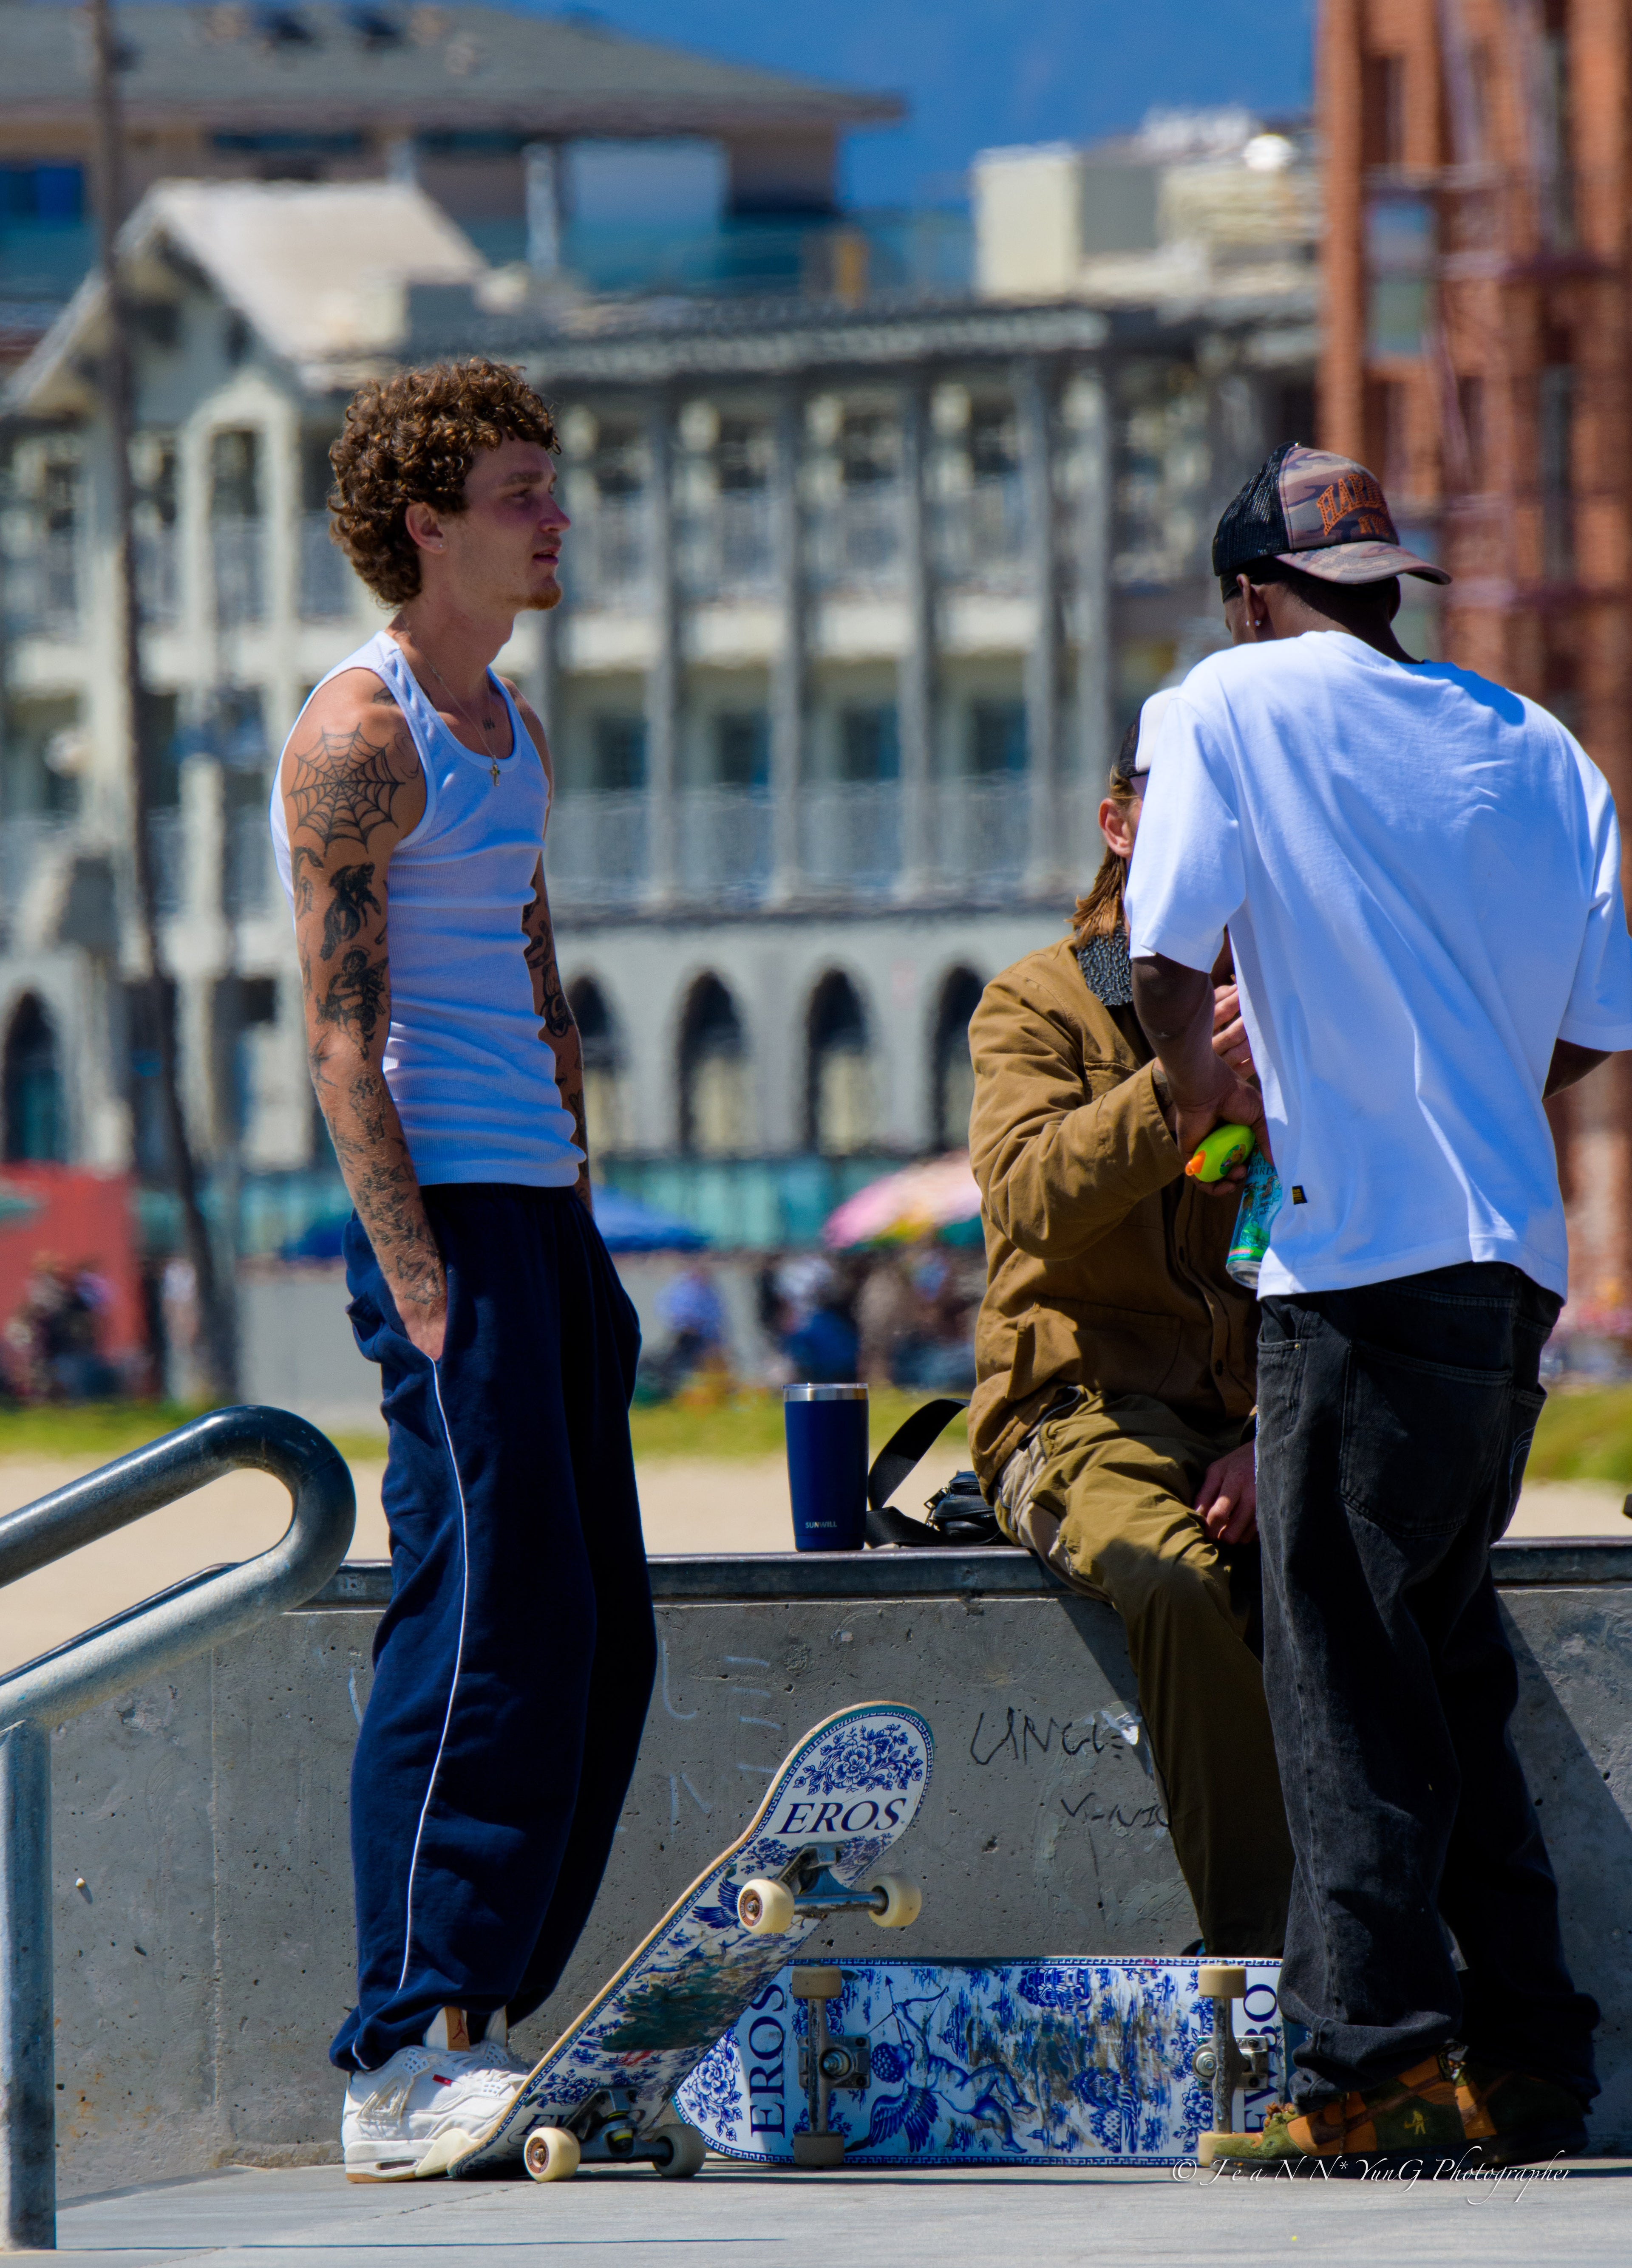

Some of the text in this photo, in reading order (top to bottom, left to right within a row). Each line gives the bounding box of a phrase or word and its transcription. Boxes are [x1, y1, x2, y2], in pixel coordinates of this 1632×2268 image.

[1248, 1167, 1274, 1176] HARD
[805, 1521, 837, 1529] SUNWILL
[774, 1797, 908, 1835] EROS
[748, 1983, 787, 2139] EROS
